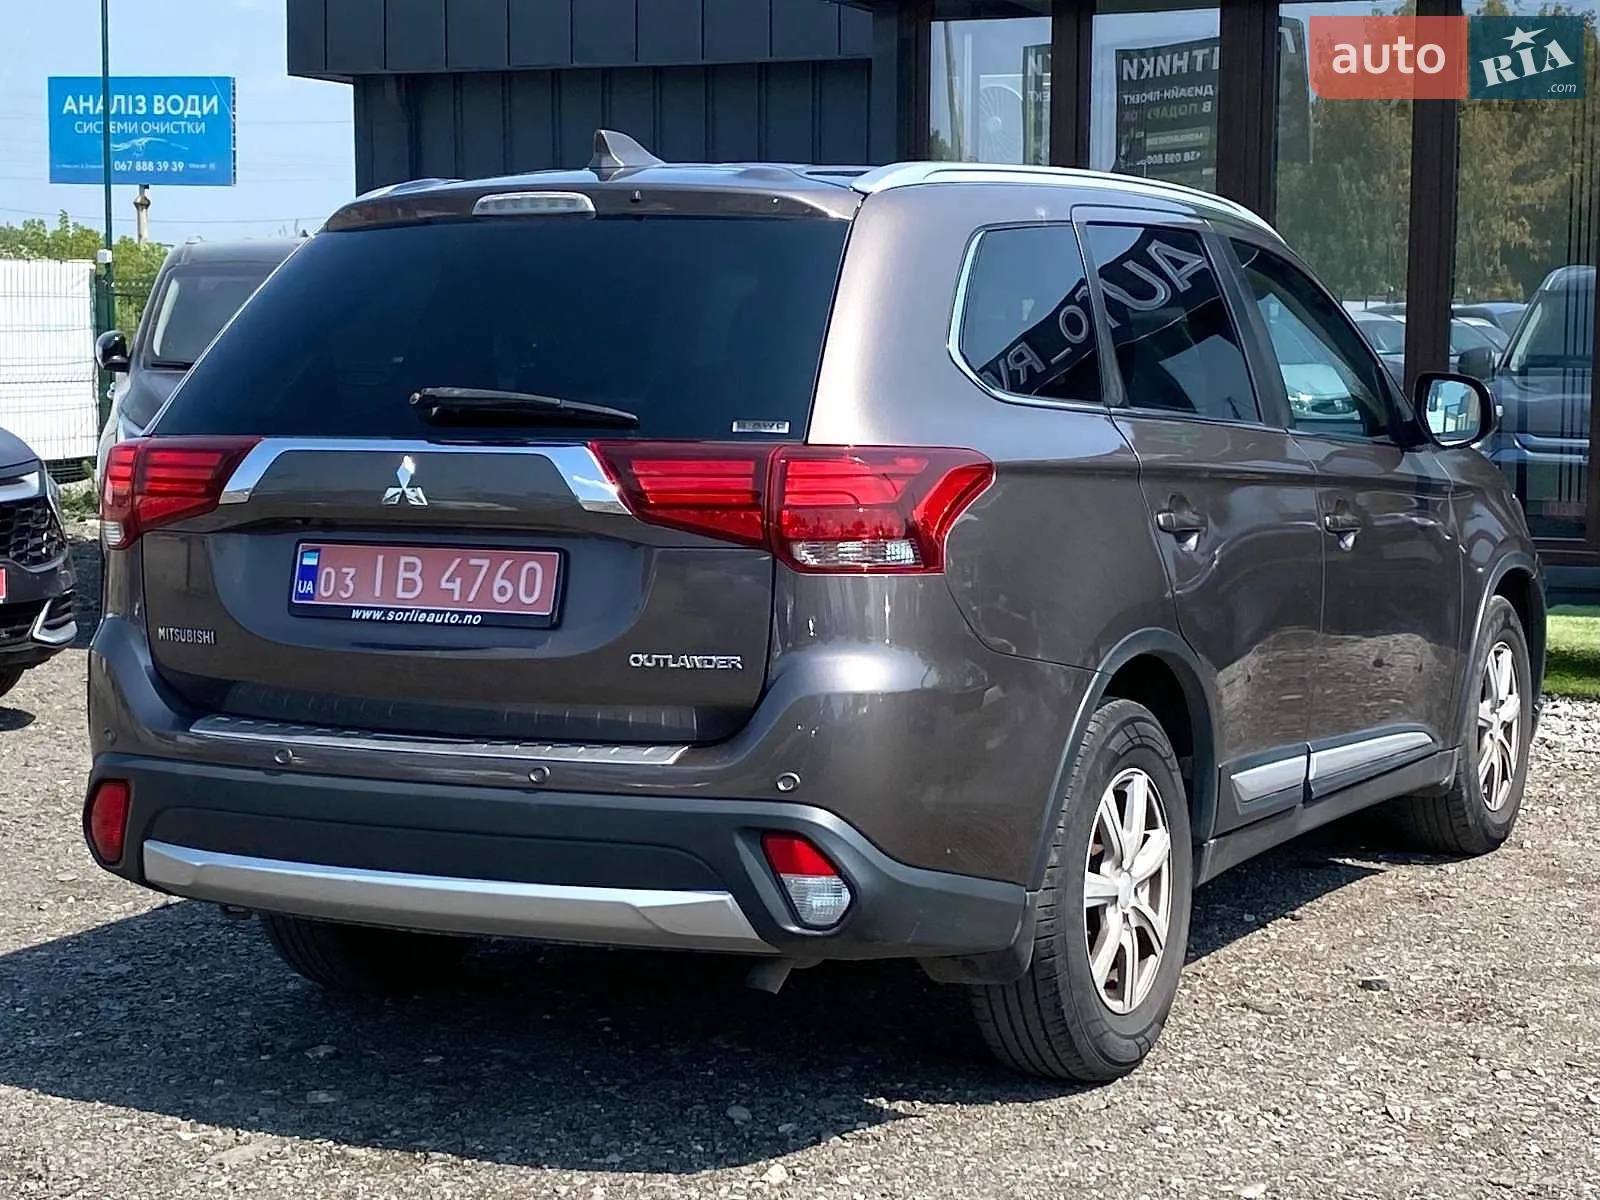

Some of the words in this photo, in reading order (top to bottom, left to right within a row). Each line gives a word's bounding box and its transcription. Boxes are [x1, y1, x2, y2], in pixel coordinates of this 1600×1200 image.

[62, 94, 148, 115] АНАЛІЗ
[152, 94, 219, 118] ВОДИ
[74, 121, 138, 134] СИСЕМИ
[141, 120, 205, 135] ОЧИСТКИ
[113, 160, 132, 172] 067
[135, 160, 153, 172] 888
[156, 160, 169, 172] 39
[171, 160, 185, 172] 39
[298, 579, 314, 594] UA
[319, 566, 357, 598] 03
[373, 554, 424, 600] IB
[439, 557, 544, 605] 4760
[351, 608, 482, 625] www.sorlieauto.no
[158, 626, 215, 645] MITSUBISHI
[629, 653, 743, 670] OUTLANDER
